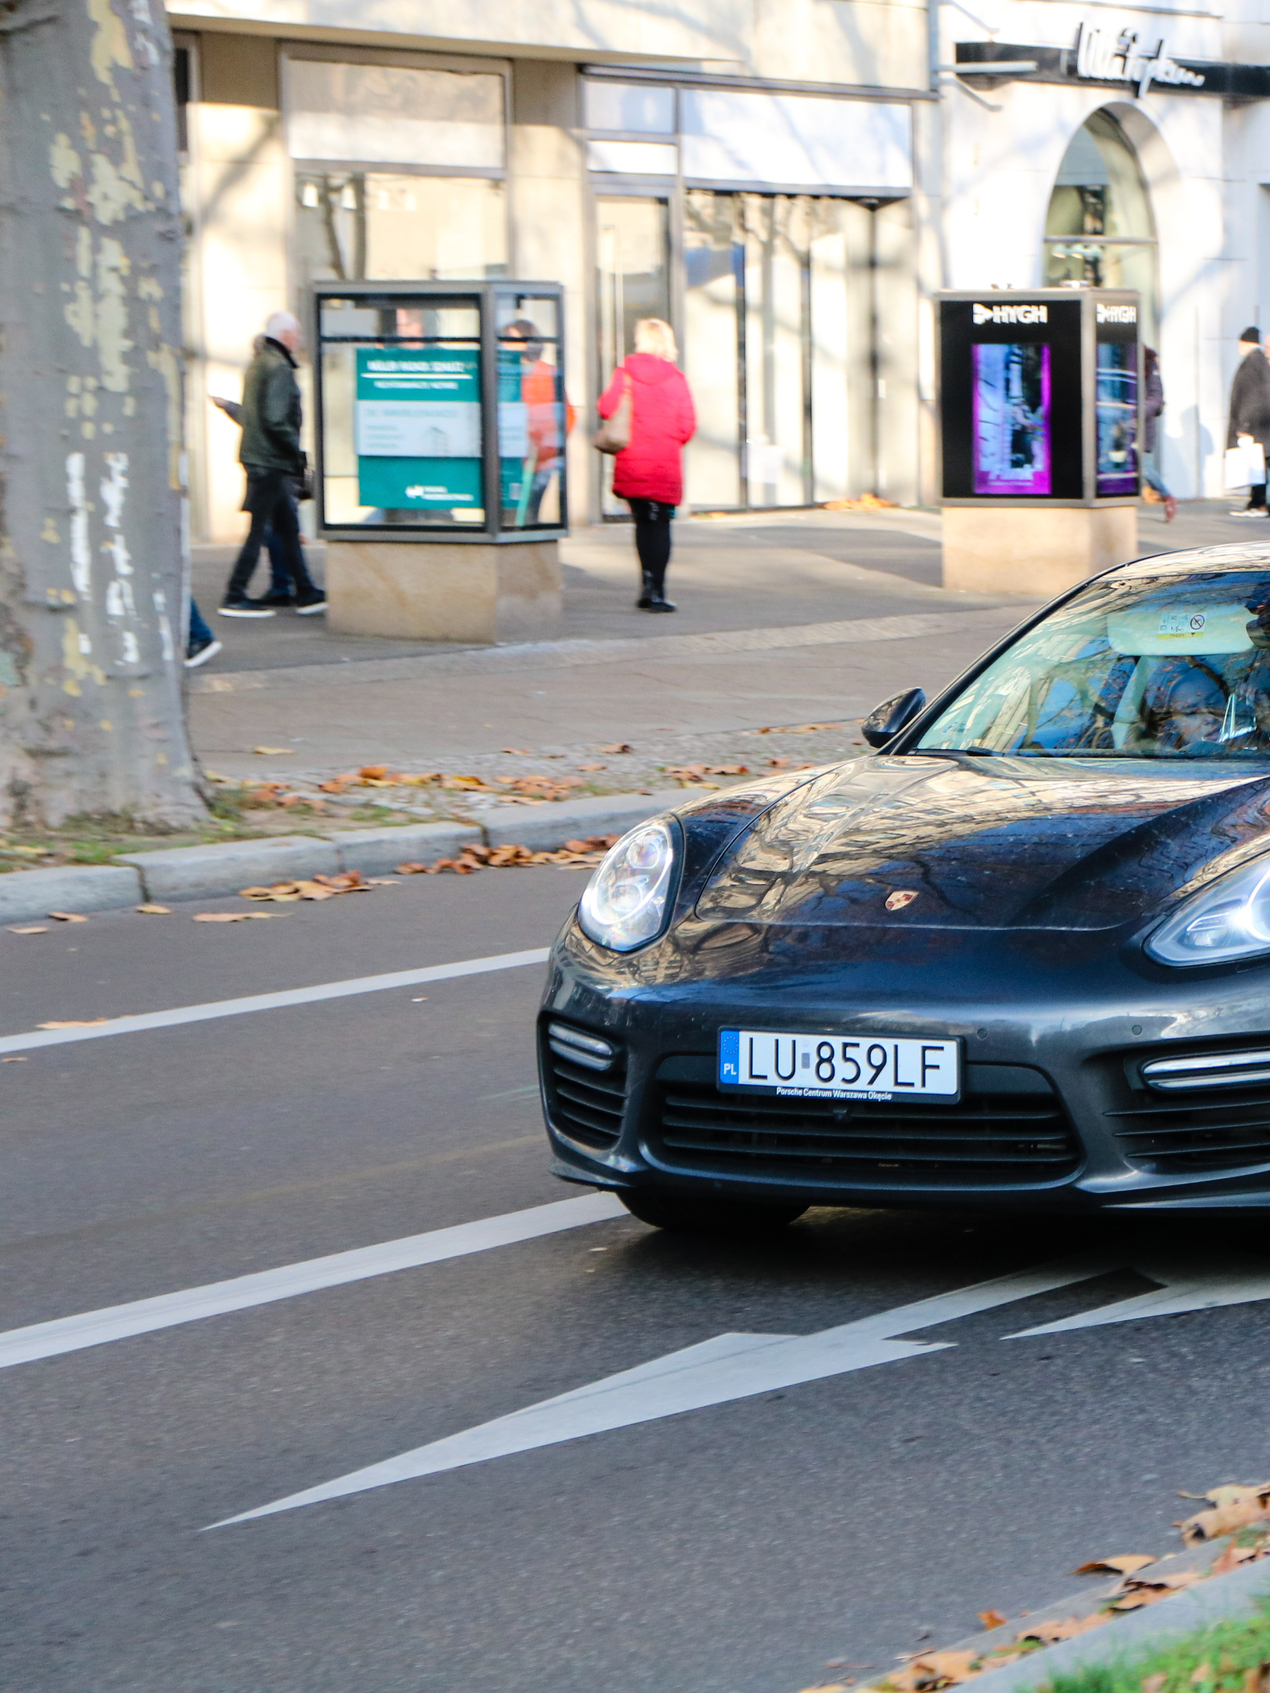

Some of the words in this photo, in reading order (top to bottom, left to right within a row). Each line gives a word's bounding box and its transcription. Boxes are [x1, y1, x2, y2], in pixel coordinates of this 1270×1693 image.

[748, 1037, 796, 1081] LU
[815, 1041, 945, 1088] 859LF
[723, 1063, 737, 1075] PL
[776, 1087, 802, 1097] Porsche
[803, 1088, 832, 1098] Centrum
[833, 1090, 867, 1099] Warszawa
